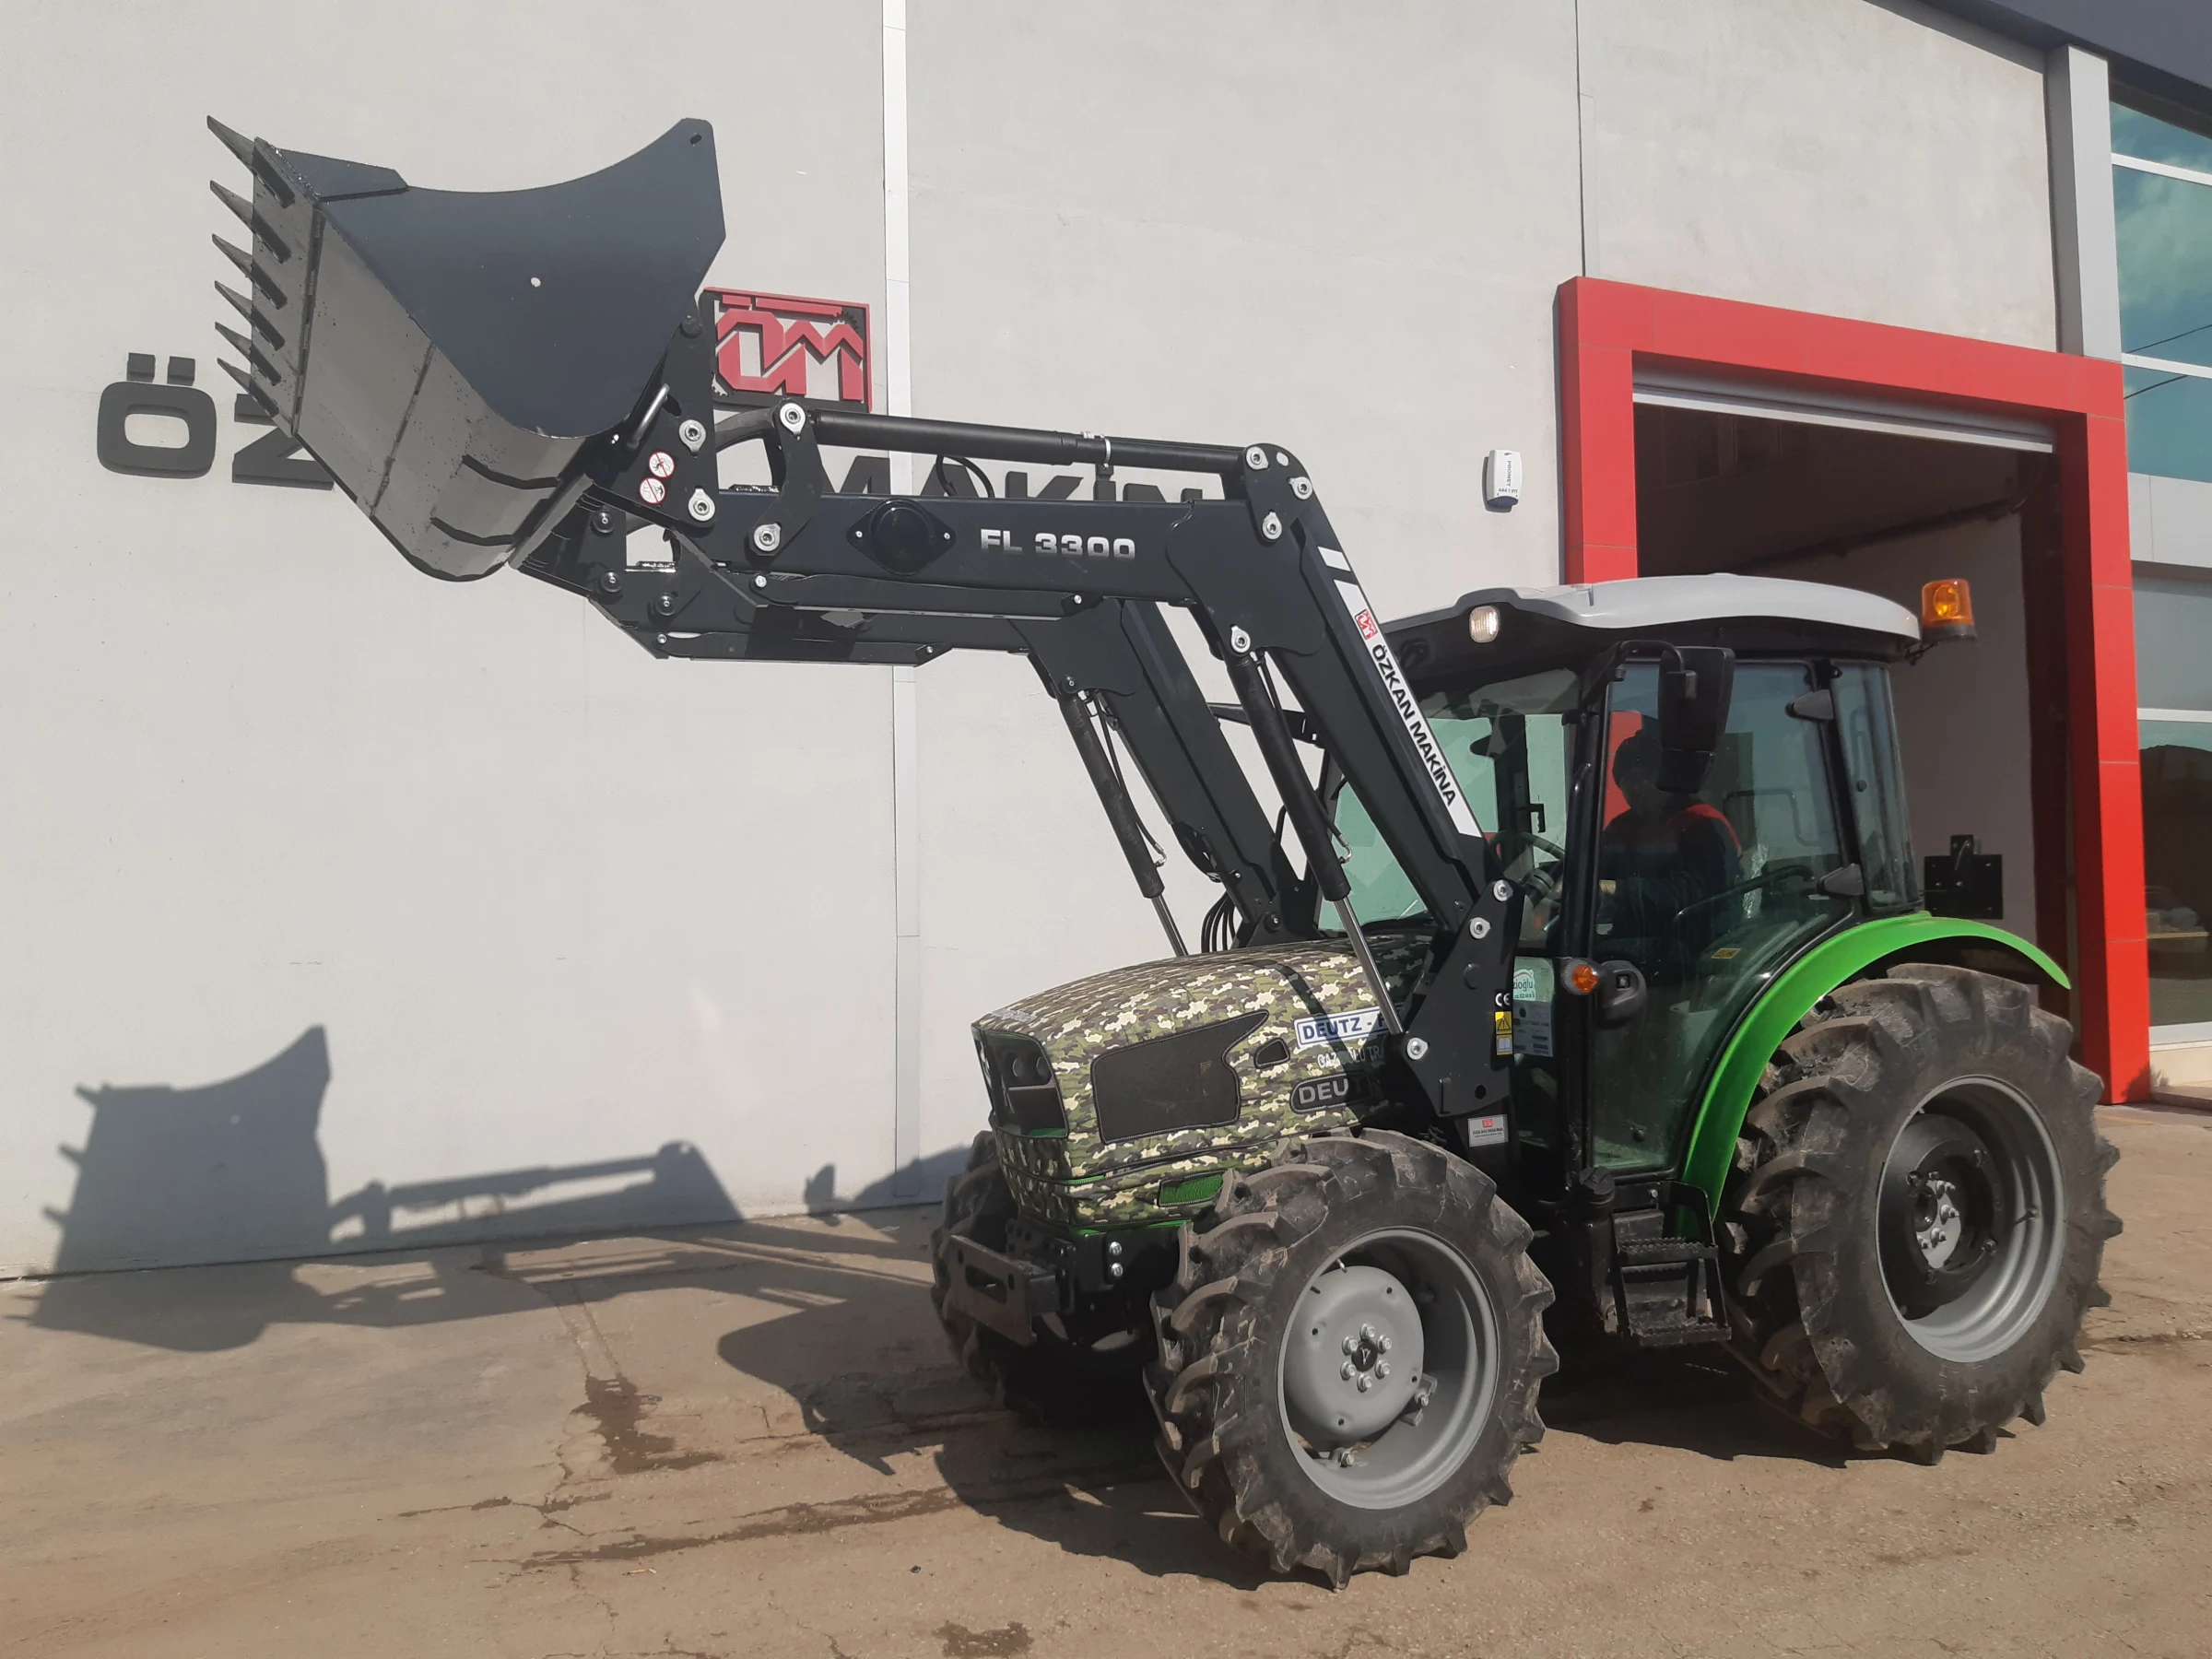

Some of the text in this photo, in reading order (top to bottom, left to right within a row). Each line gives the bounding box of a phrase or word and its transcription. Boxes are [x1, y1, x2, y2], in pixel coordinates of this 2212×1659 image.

[980, 528, 1135, 560] FL 3300
[1371, 643, 1456, 807] ÖZKAN MAKİNA
[1512, 978, 1534, 993] zioğlu
[1302, 1017, 1362, 1041] DEUTZ
[1298, 1078, 1349, 1105] DEU
